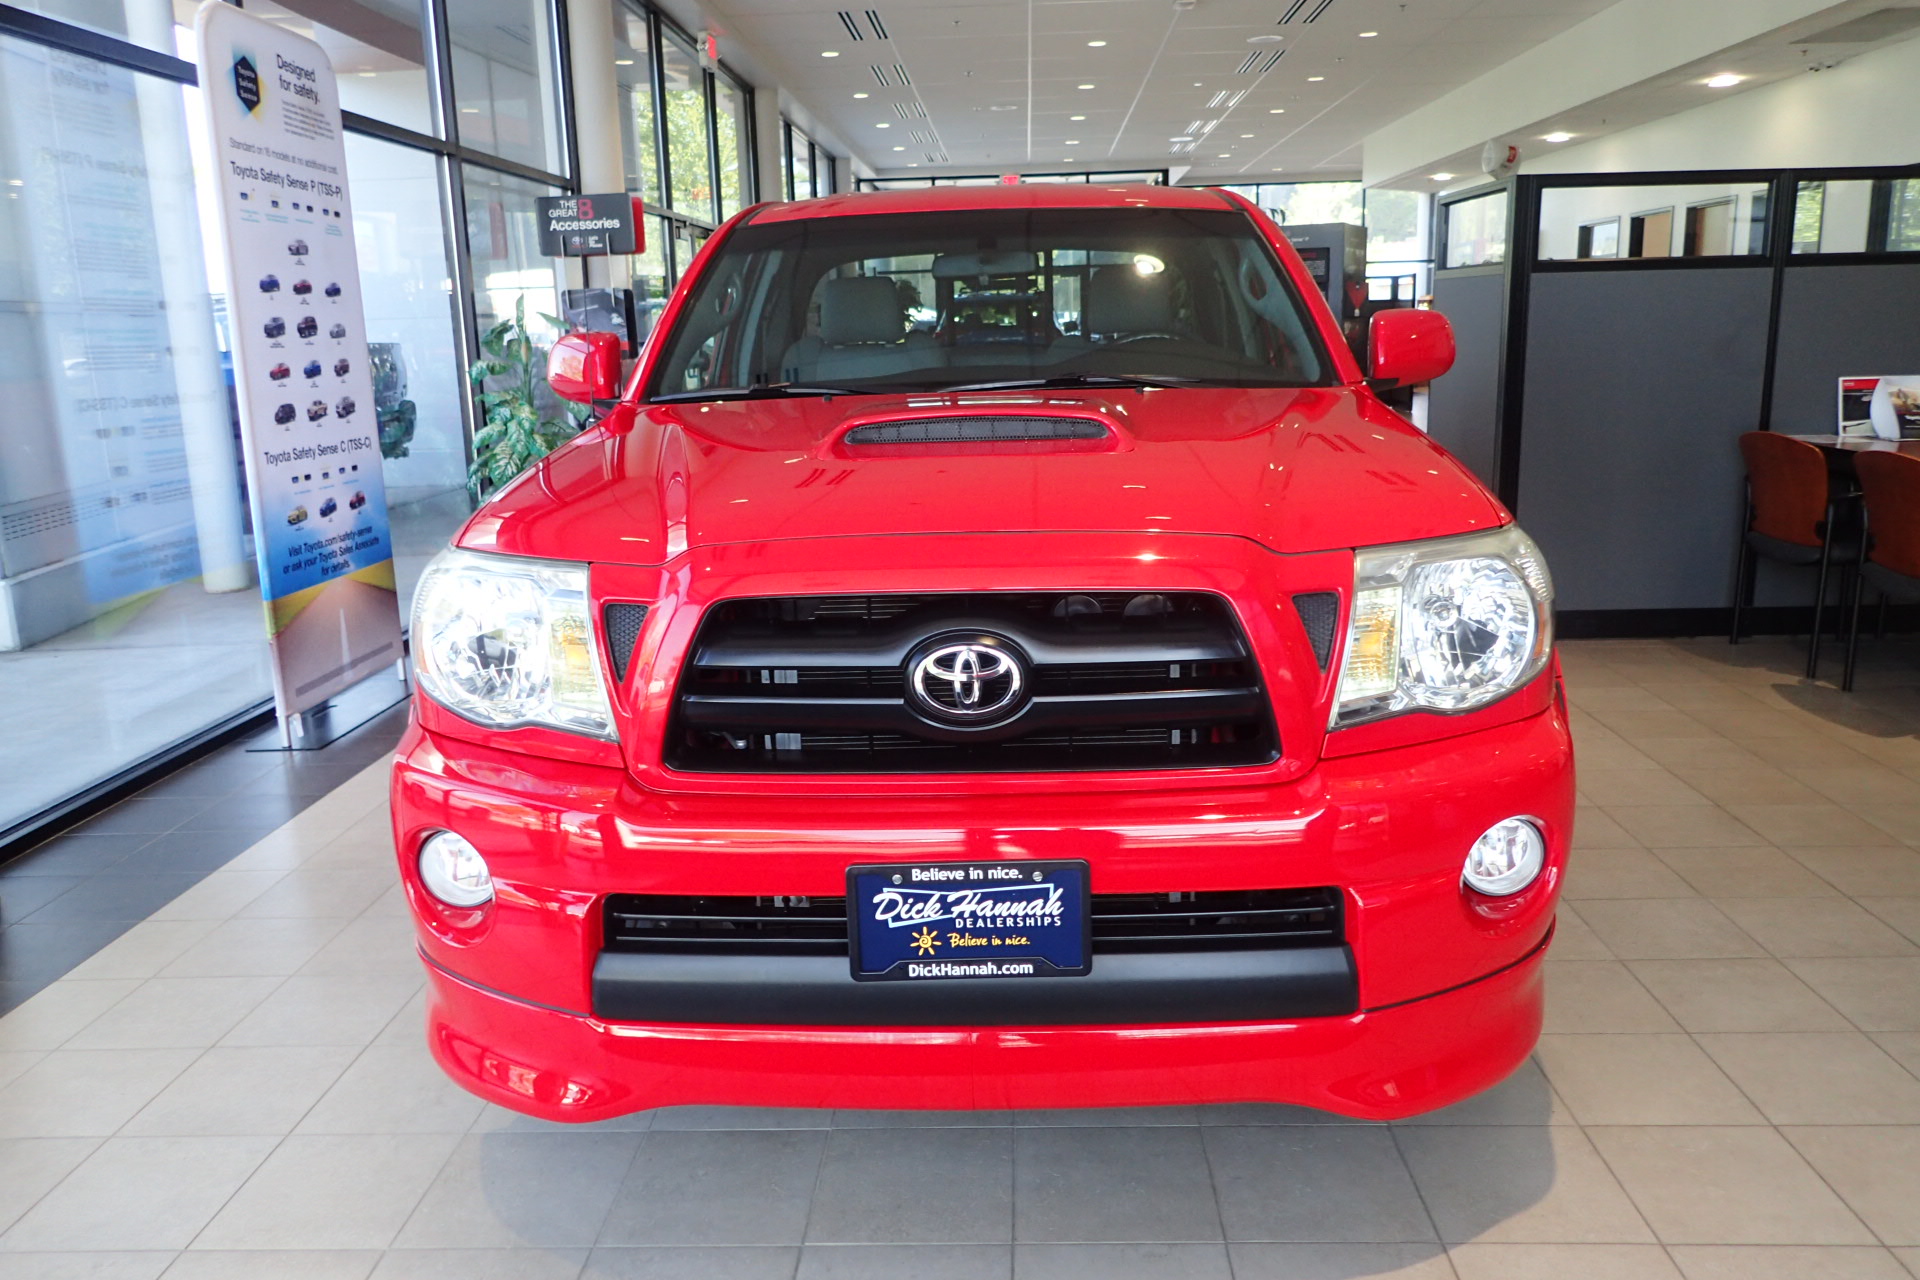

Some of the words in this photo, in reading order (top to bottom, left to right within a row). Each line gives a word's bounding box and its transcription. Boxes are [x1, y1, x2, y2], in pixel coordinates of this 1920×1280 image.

[276, 53, 316, 83] Designed
[279, 75, 291, 92] for
[294, 83, 320, 105] safety.
[229, 137, 256, 154] Standard
[272, 151, 290, 163] models
[230, 160, 259, 181] Toyota
[260, 167, 285, 189] Safety
[286, 174, 309, 191] Sense
[311, 179, 316, 193] P
[317, 181, 343, 201] (TSS-P)
[559, 200, 578, 209] THE
[578, 199, 594, 219] 8
[548, 208, 578, 218] GREAT
[549, 217, 620, 232] Accessories
[264, 451, 291, 466] Toyota
[292, 447, 316, 461] Safety
[317, 443, 338, 457] Sense
[340, 440, 346, 453] C
[347, 436, 372, 454] (TSS-C)
[288, 544, 302, 557] Visit
[283, 565, 290, 575] or
[291, 559, 303, 572] ask
[303, 556, 318, 570] your
[318, 550, 338, 563] Toyota
[339, 544, 354, 557] Sales
[321, 565, 330, 576] for
[911, 867, 964, 881] Believe
[969, 866, 984, 880] in
[987, 867, 1023, 880] nice.
[872, 891, 944, 921] Dick
[946, 887, 1064, 919] Hannah
[955, 916, 1062, 929] DEALERSHIPS
[947, 932, 988, 948] Believe
[991, 934, 1002, 946] in
[1005, 935, 1031, 947] nice.
[908, 962, 1034, 978] DickHannah.com
